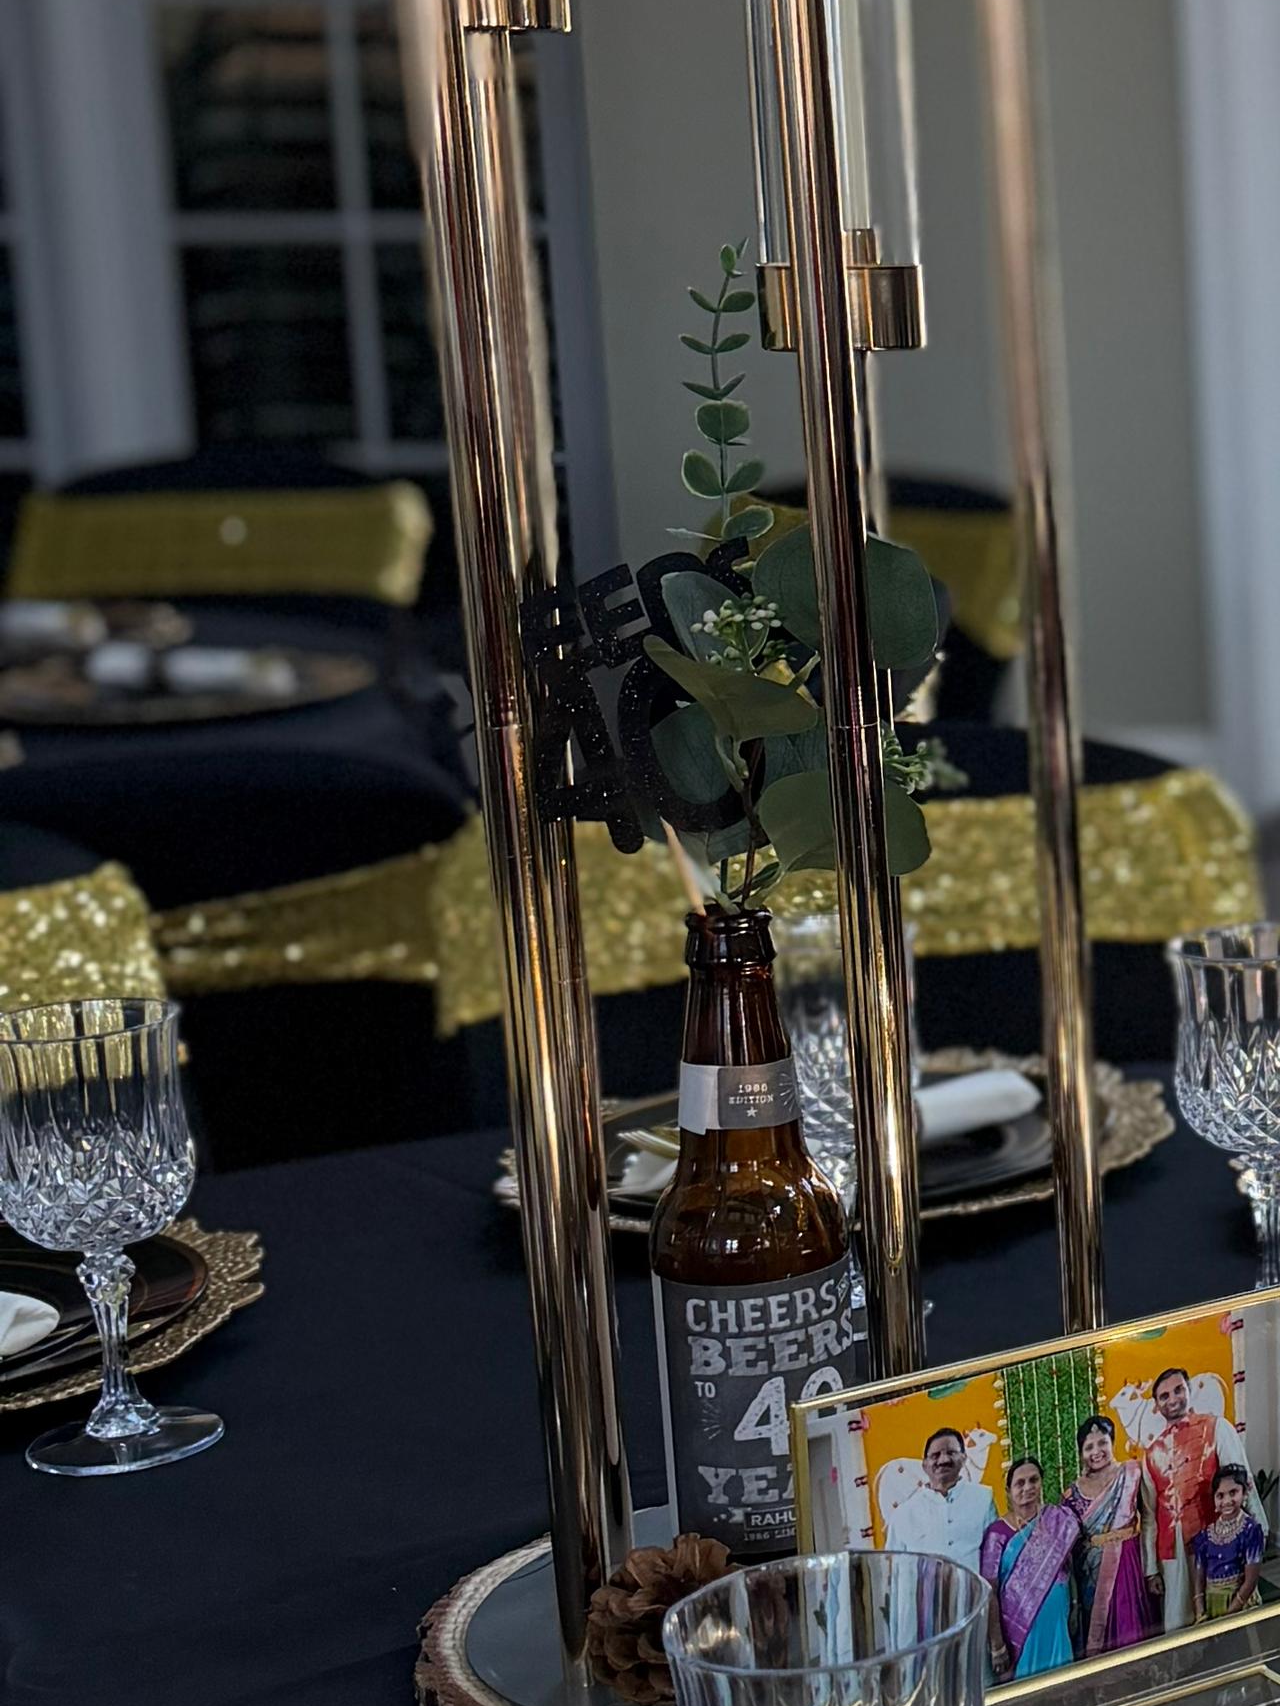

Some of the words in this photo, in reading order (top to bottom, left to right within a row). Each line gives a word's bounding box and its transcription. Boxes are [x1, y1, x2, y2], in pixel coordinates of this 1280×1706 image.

[686, 1278, 837, 1334] CHEERS
[687, 1308, 854, 1377] BEERS
[694, 1381, 716, 1398] TO
